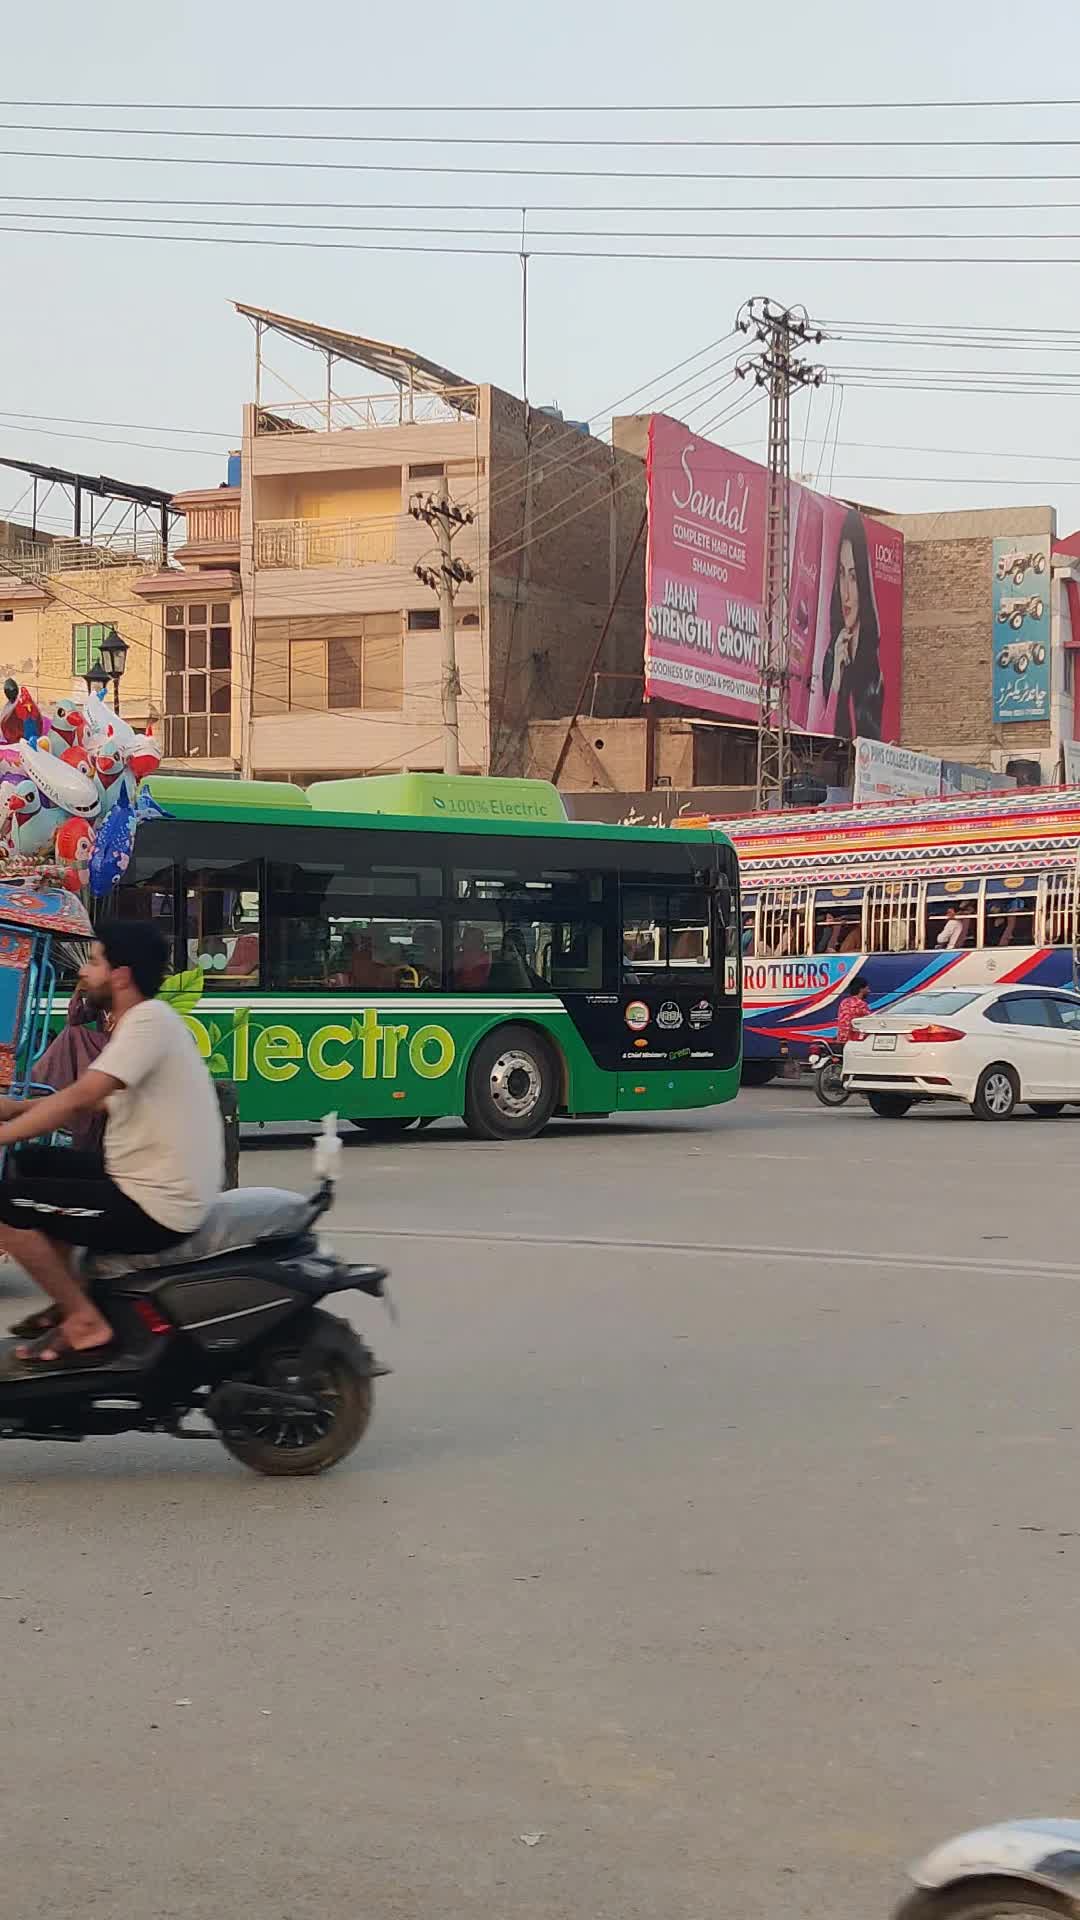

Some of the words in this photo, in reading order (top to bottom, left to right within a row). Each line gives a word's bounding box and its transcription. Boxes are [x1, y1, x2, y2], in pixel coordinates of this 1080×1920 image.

[672, 444, 749, 534] Sandal
[672, 524, 710, 550] COMPLETE
[711, 538, 728, 557] HAIR
[728, 545, 746, 564] CARE
[691, 557, 728, 583] SHAMPOO
[662, 577, 698, 613] JAHAN
[648, 604, 715, 655] STRENGTH,
[725, 599, 760, 635] WAHIN
[647, 661, 684, 680] GOODNESS
[684, 668, 694, 681] OF
[44, 784, 60, 800] PIA
[727, 962, 830, 990] BROTHERS
